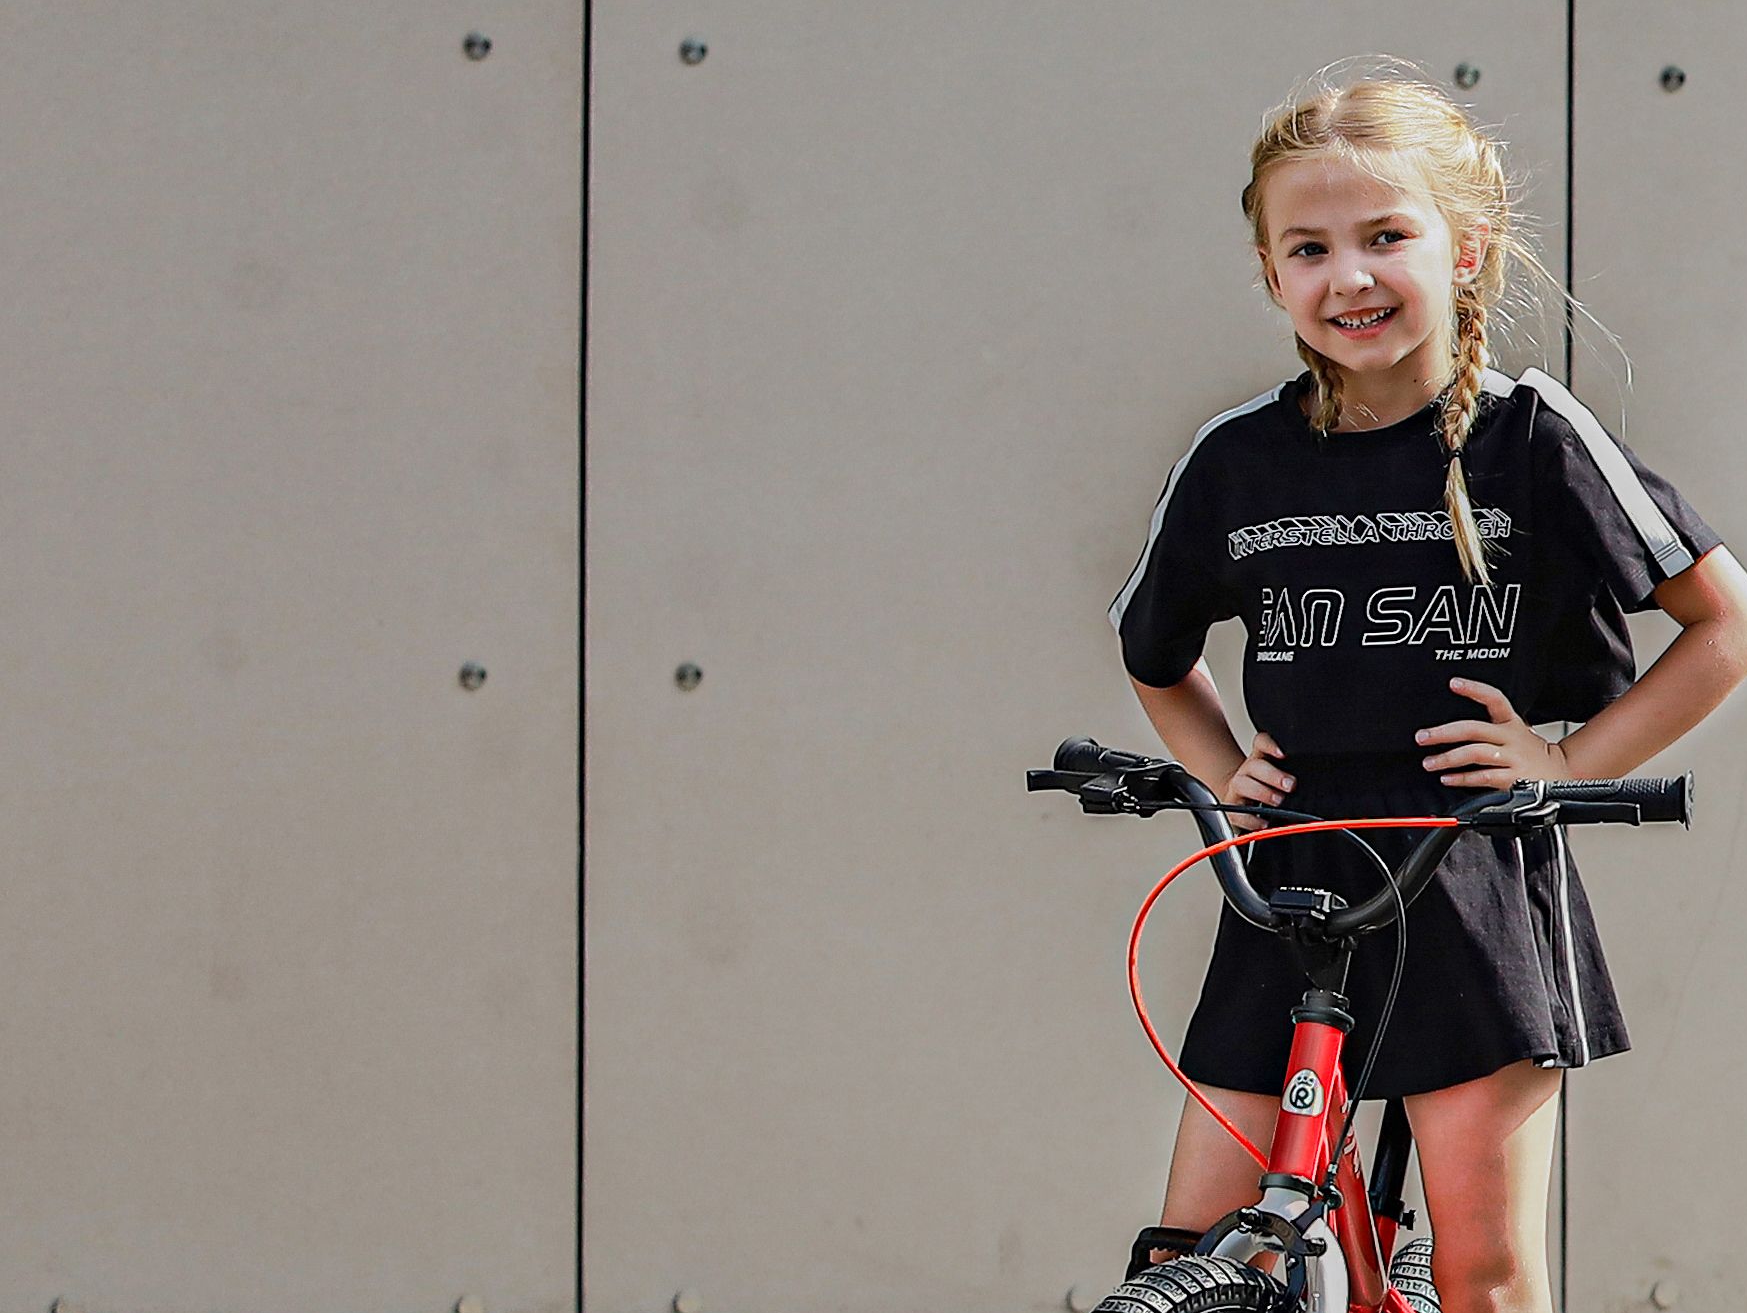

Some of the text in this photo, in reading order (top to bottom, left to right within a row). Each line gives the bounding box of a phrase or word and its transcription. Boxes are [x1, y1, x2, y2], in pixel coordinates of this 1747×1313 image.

[1376, 508, 1512, 542] THROGH
[1362, 584, 1521, 646] SAN
[1434, 647, 1511, 661] THE MOON
